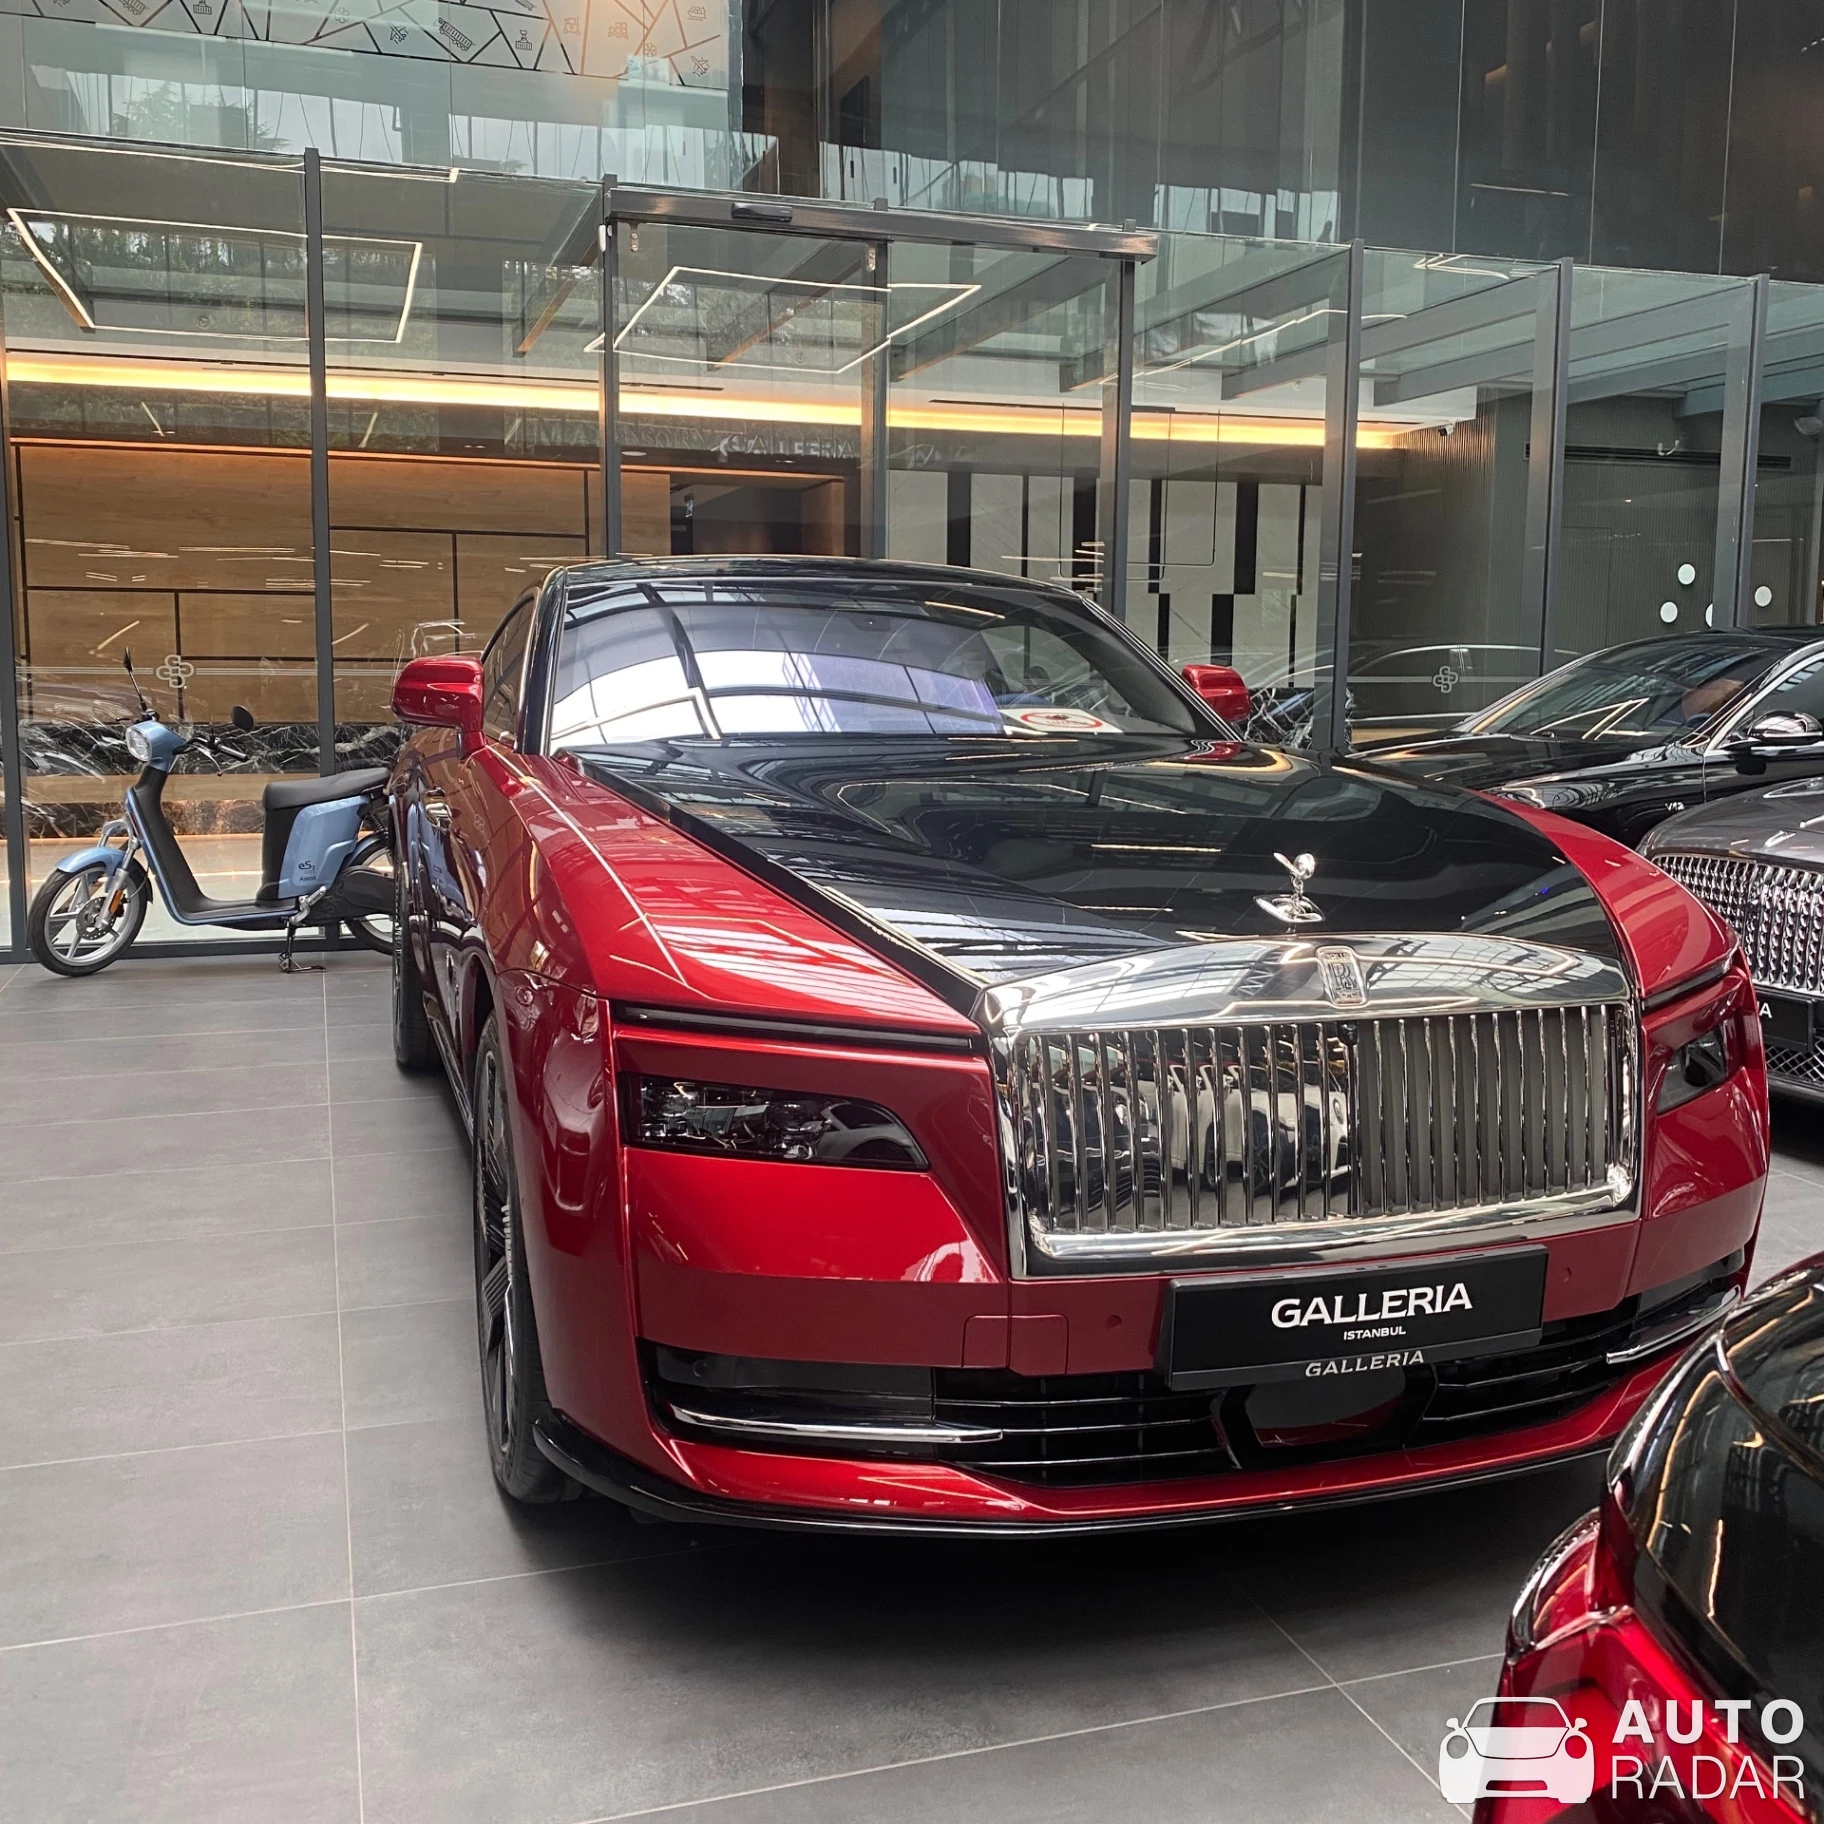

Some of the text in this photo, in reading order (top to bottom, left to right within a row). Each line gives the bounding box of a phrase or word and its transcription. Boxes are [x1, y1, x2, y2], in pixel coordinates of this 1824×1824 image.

[1271, 1283, 1473, 1328] GALLERIA
[1343, 1326, 1406, 1341] ISTANBUL
[1305, 1350, 1425, 1378] GALLERIA
